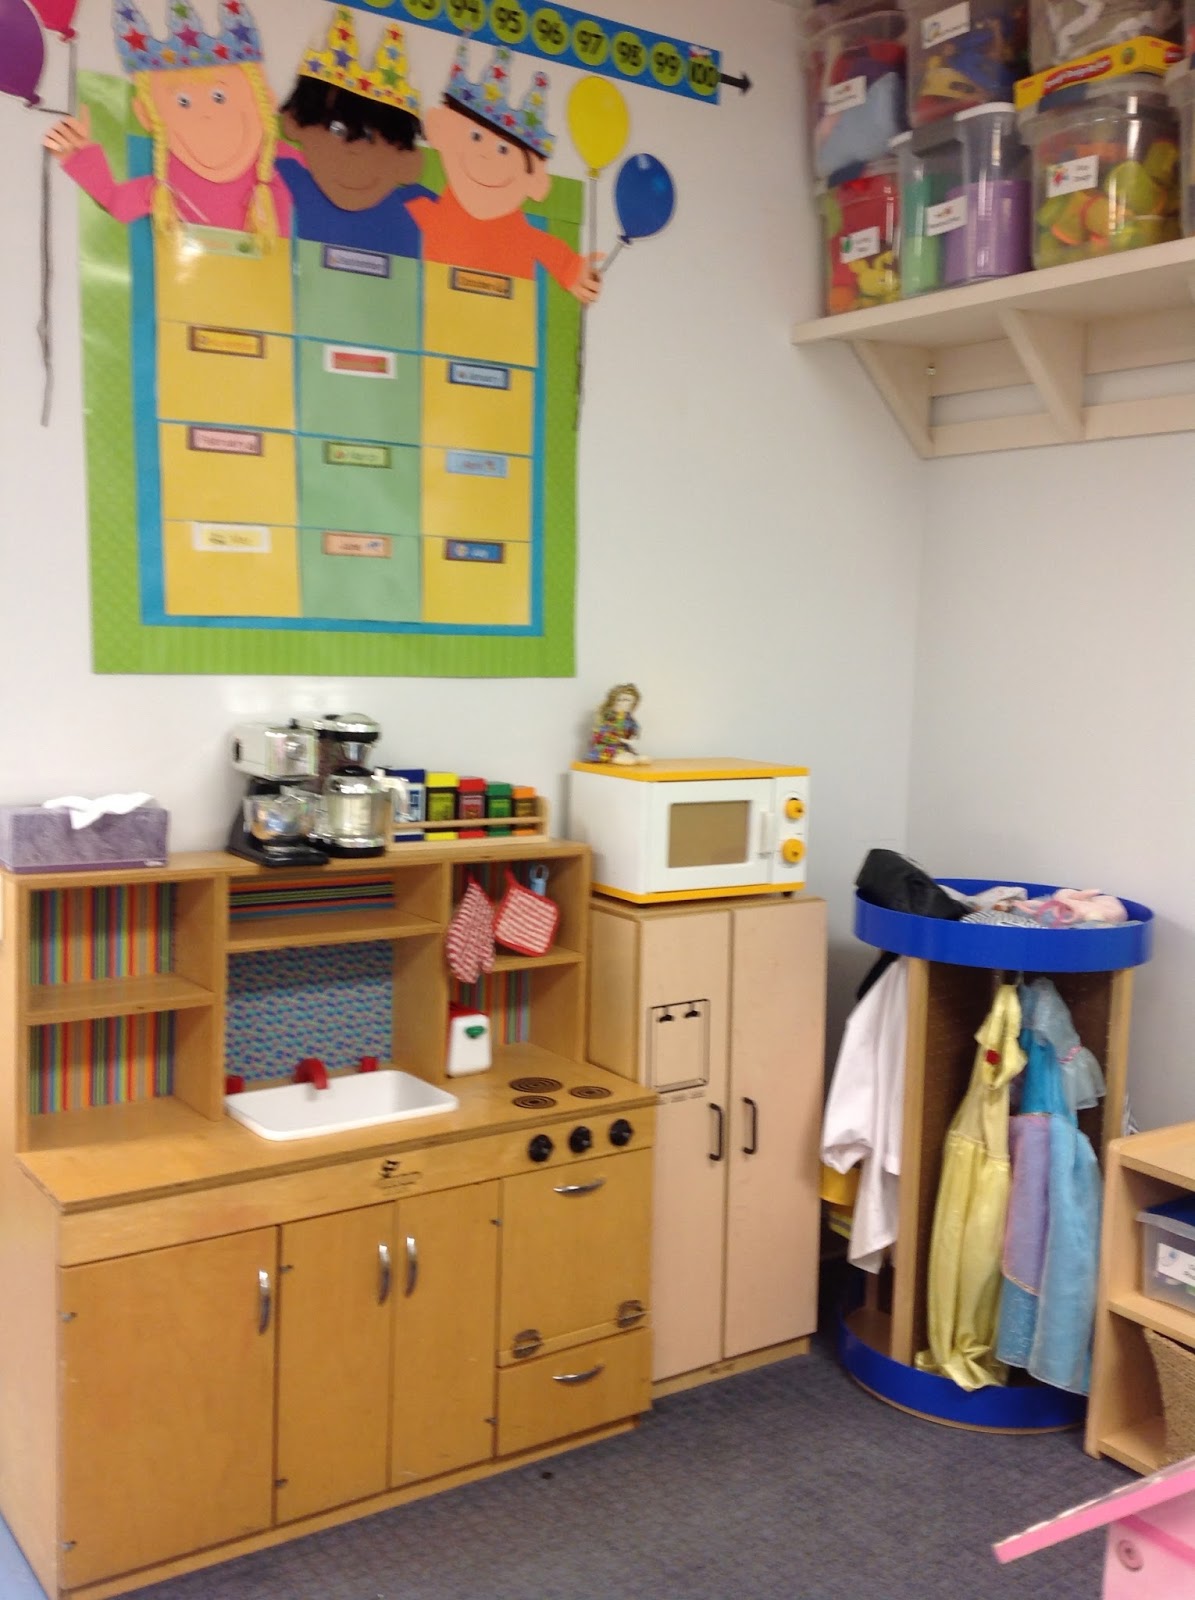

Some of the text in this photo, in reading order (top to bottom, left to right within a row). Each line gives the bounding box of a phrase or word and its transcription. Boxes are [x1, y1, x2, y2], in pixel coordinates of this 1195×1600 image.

[494, 6, 521, 34] 95
[536, 18, 565, 45] 96
[576, 30, 604, 55] 97
[616, 41, 642, 67] 98
[653, 51, 680, 77] 99
[689, 60, 718, 87] 100
